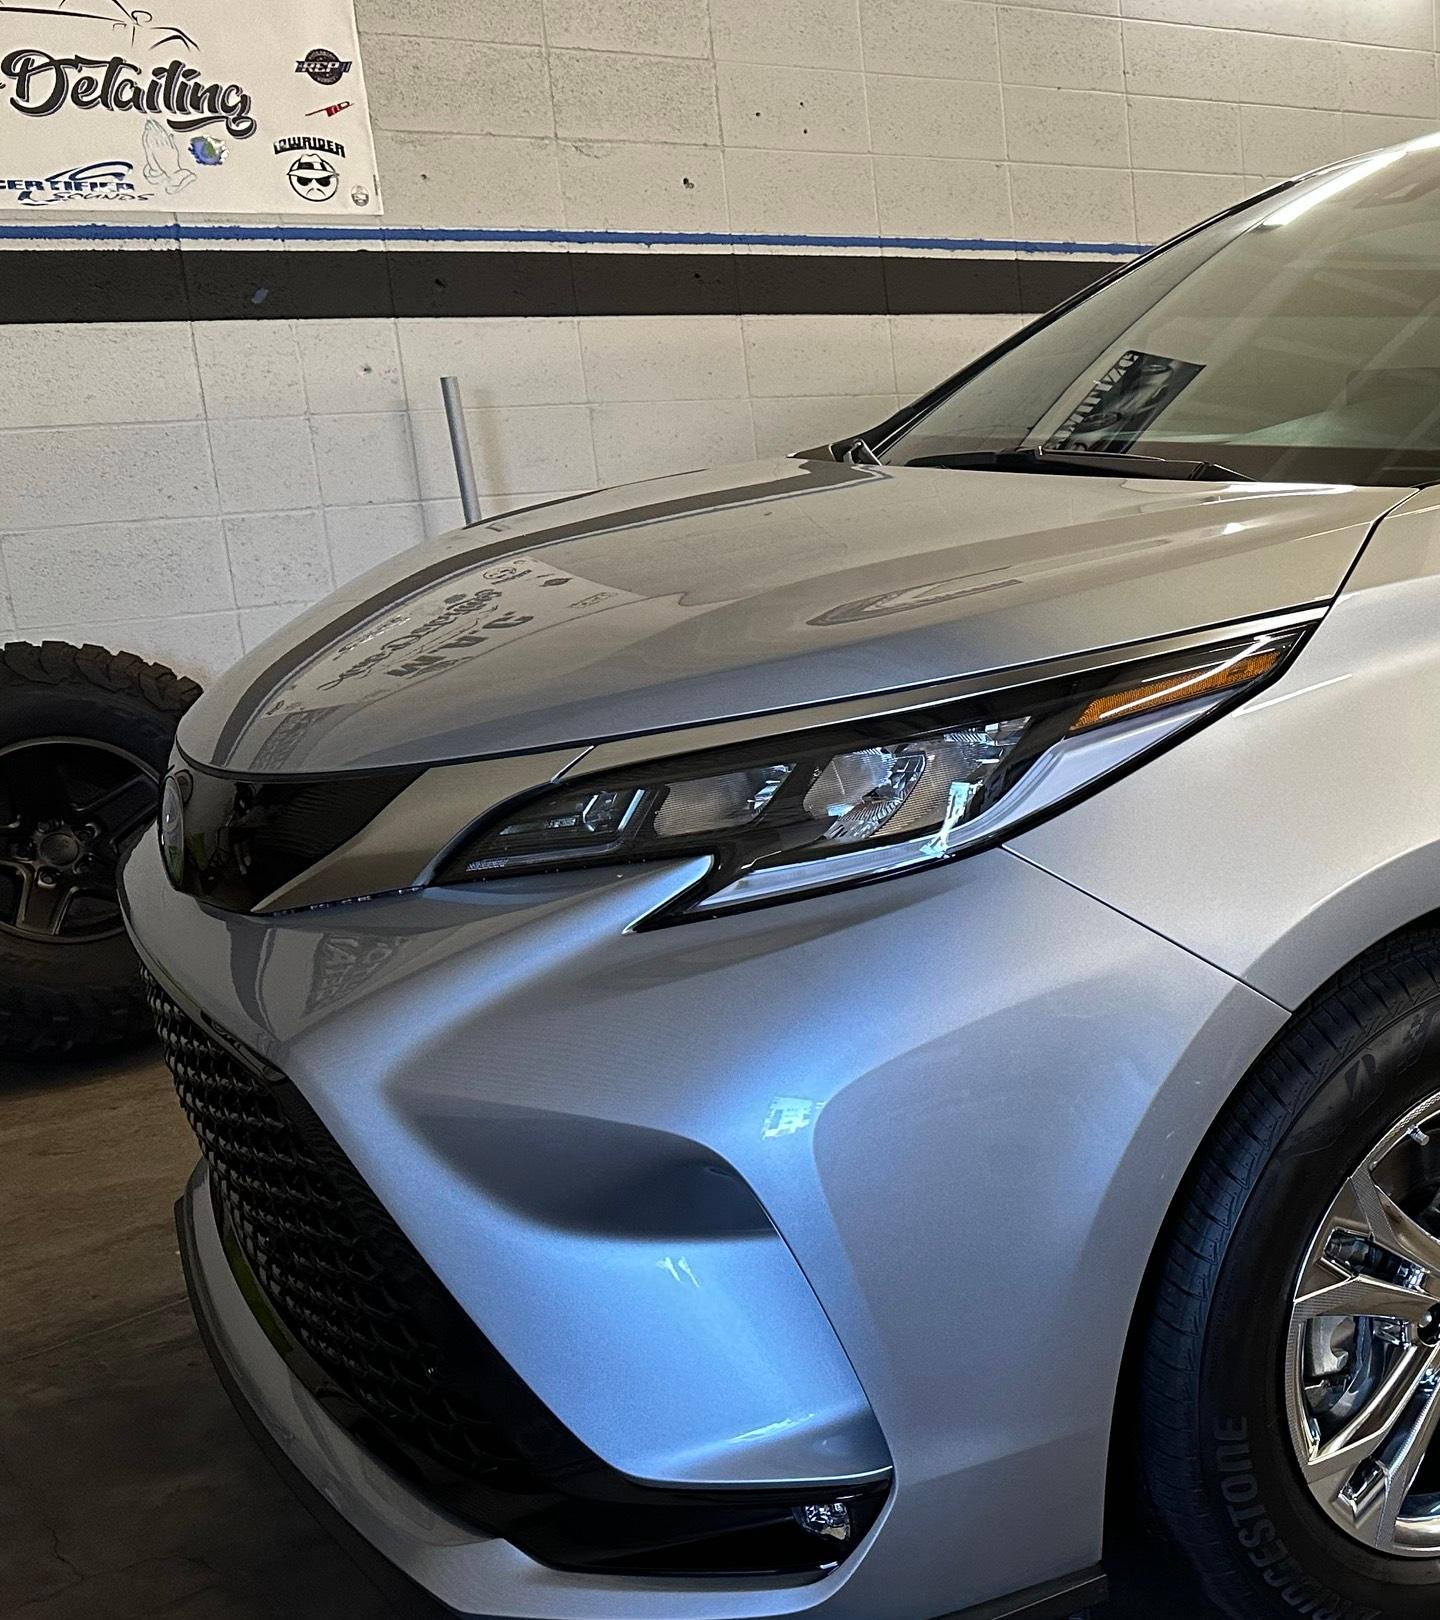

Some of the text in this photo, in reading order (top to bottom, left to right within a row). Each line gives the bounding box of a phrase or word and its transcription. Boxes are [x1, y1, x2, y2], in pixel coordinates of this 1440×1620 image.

[1, 48, 257, 140] Detailing
[273, 136, 346, 158] LOWRIDER
[52, 191, 155, 201] SOUNDS
